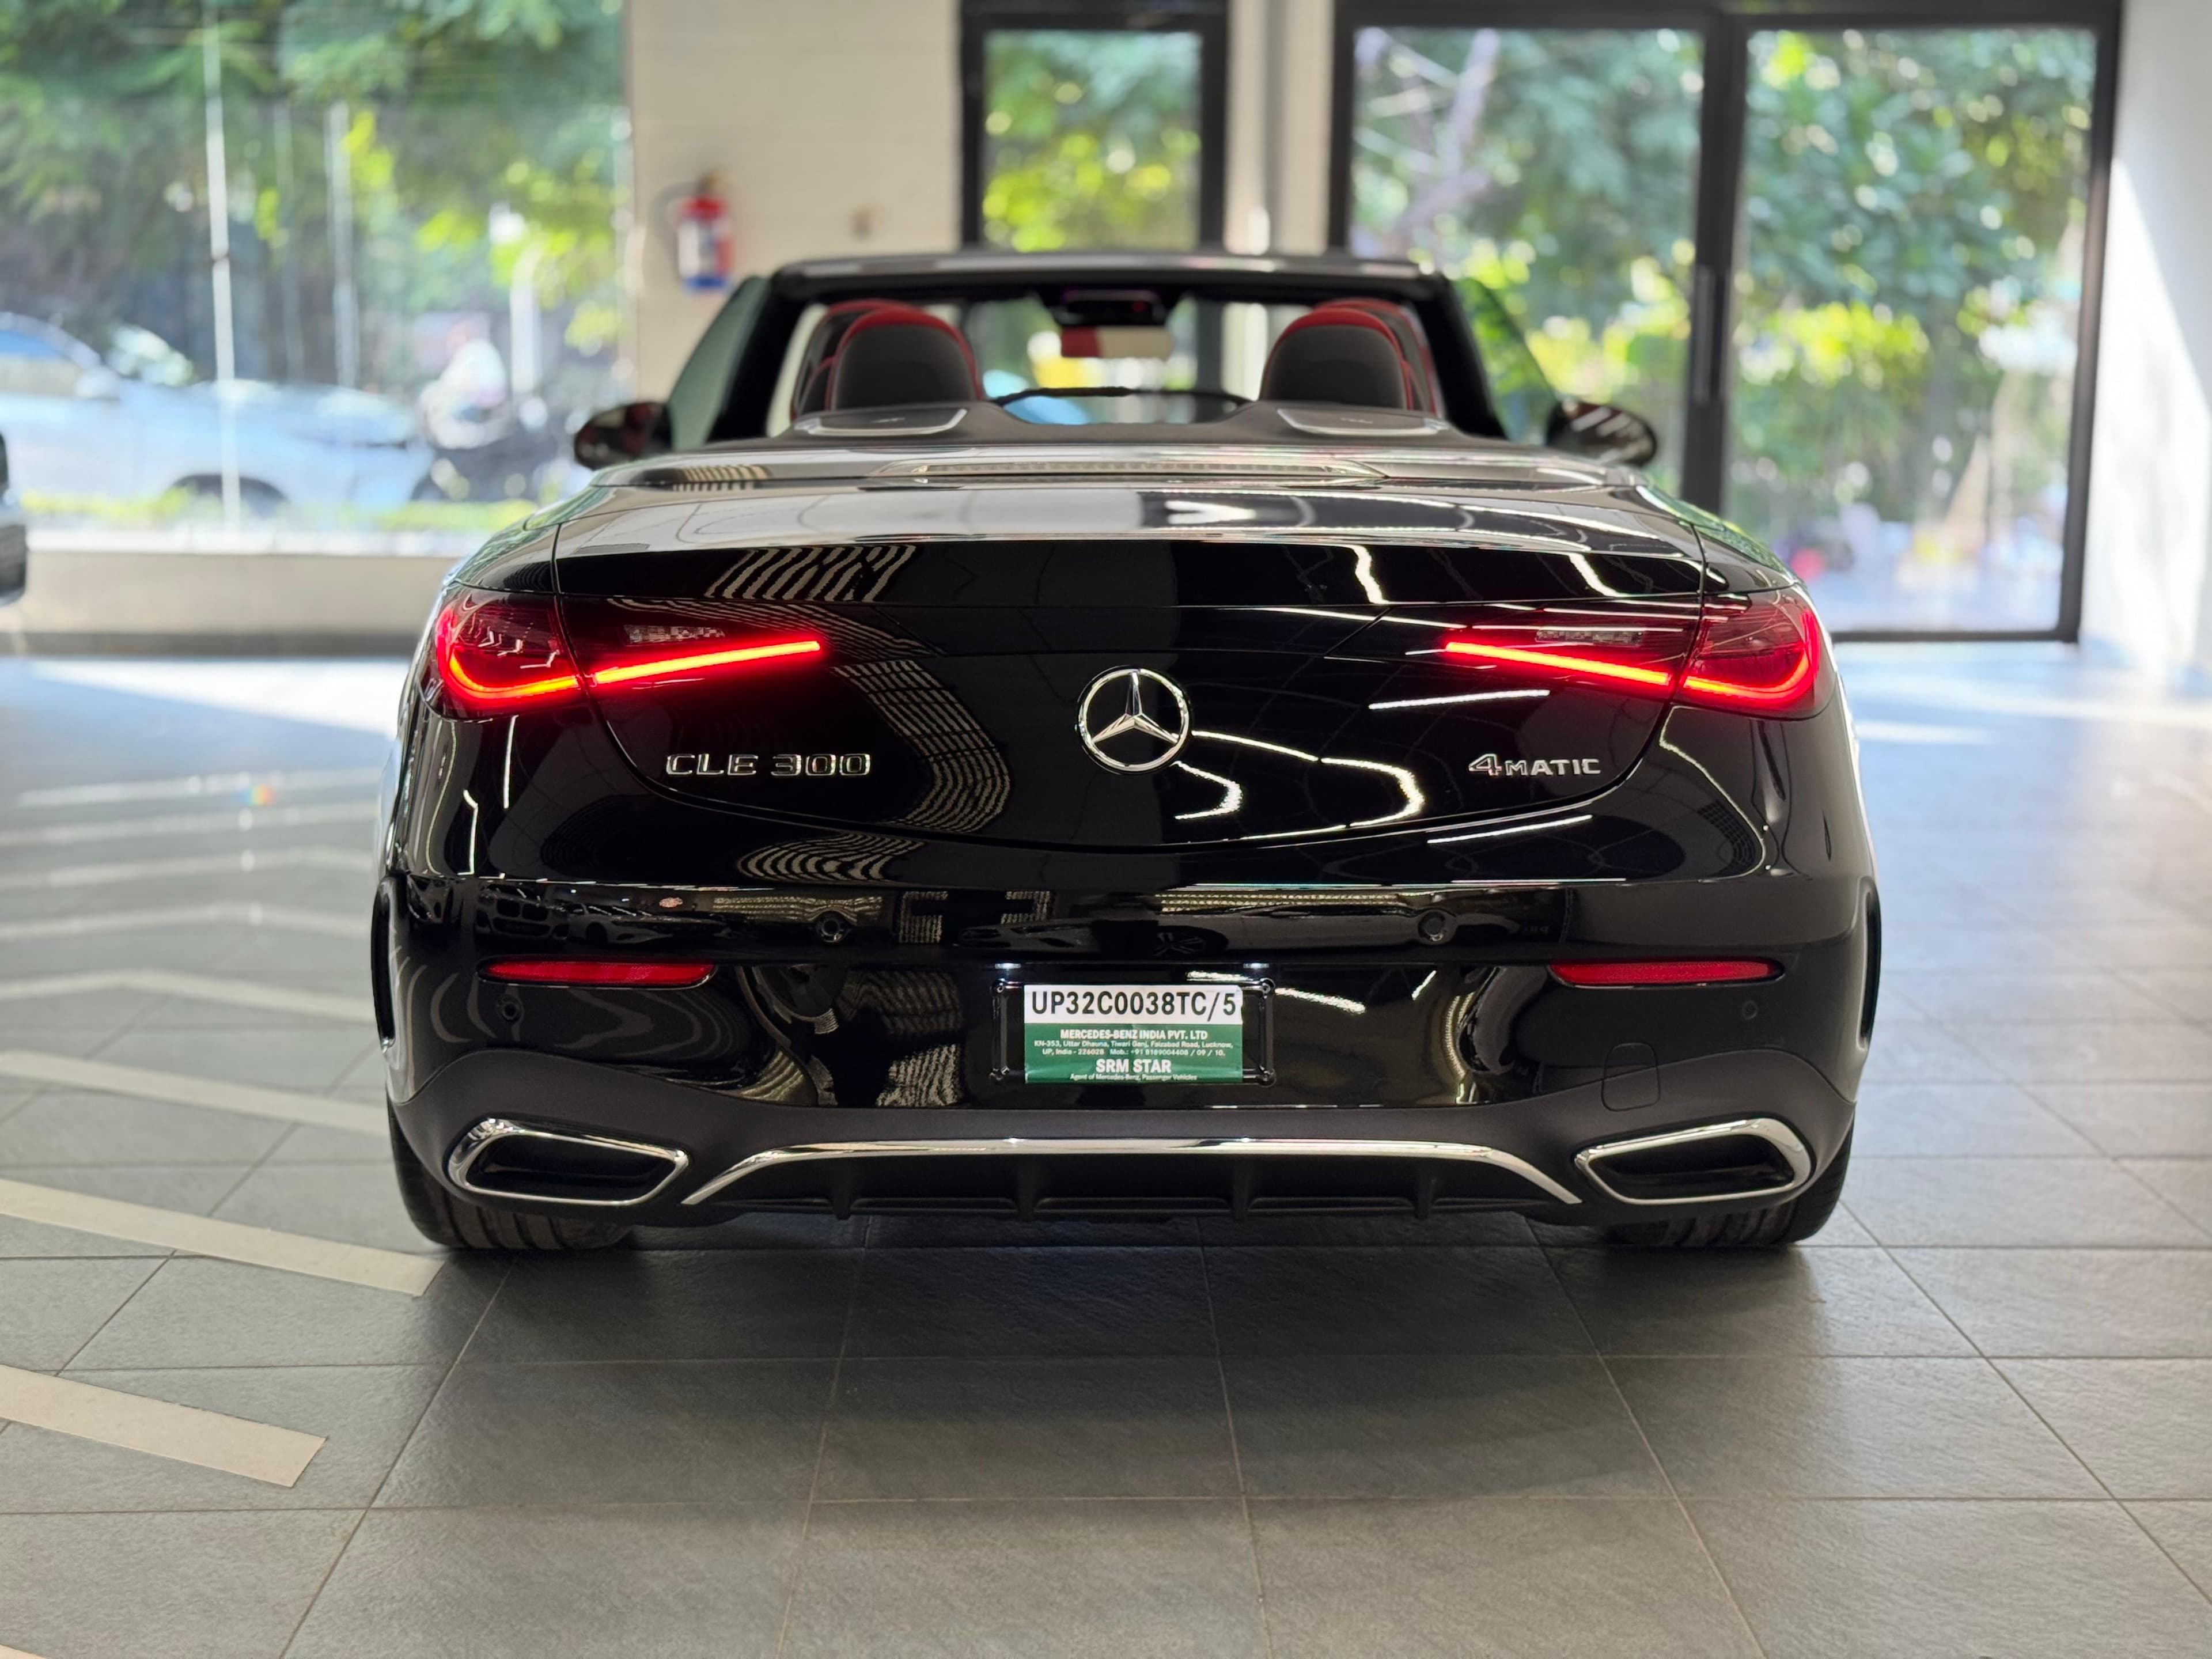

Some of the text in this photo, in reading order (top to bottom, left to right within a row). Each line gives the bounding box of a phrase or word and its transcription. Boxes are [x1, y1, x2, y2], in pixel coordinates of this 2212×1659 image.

[666, 753, 871, 777] CLE 300
[1032, 991, 1236, 1021] UP32C0038TC/5
[1060, 1029, 1208, 1040] MERCEDES-BENZ INDIA PVT. LTD
[1096, 1058, 1172, 1073] SRM STAR
